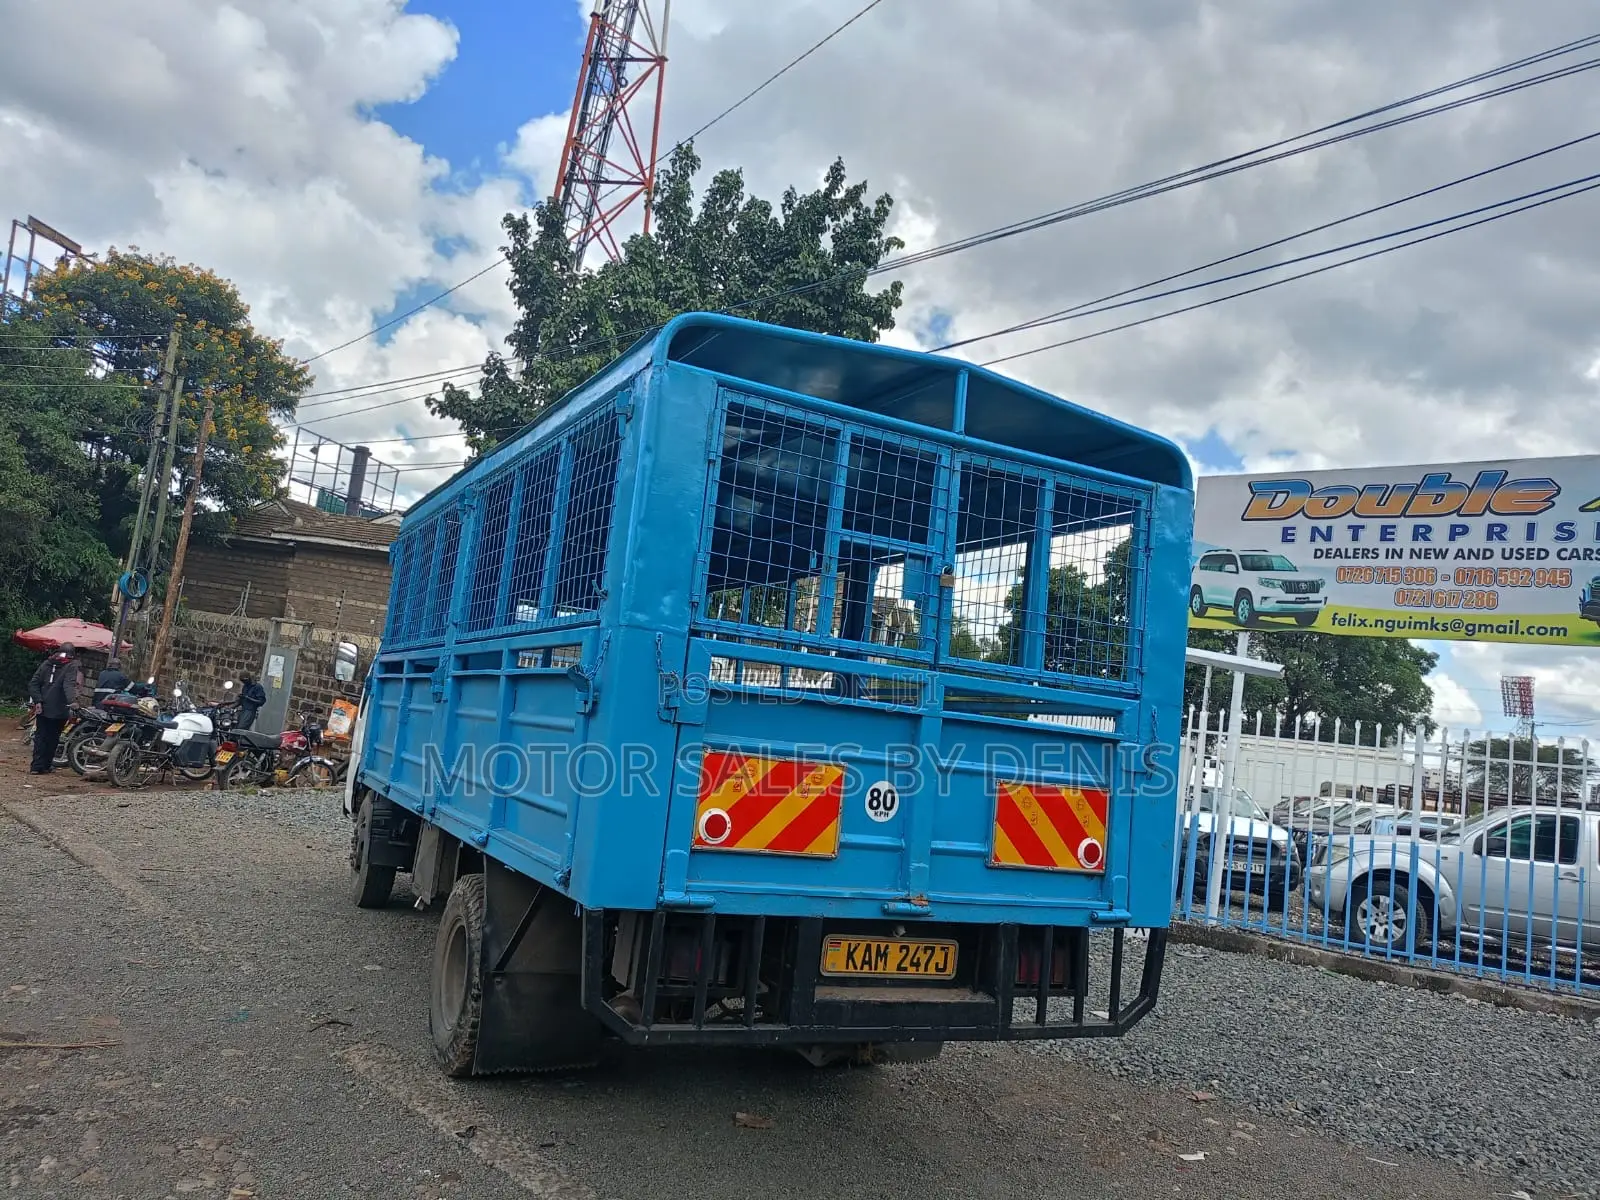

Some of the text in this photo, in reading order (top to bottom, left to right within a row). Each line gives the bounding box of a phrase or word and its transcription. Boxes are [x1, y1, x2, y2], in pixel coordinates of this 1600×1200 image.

[1241, 469, 1561, 521] Double
[1281, 521, 1600, 544] ENTERPRIS
[1313, 547, 1600, 561] DEALERS IN NEW AND USED CARS
[1336, 566, 1374, 584] 0726
[1375, 566, 1402, 584] 715
[1403, 566, 1437, 585] 306
[1454, 567, 1494, 586] 0716
[1496, 568, 1533, 587] 592
[1534, 568, 1572, 588] 945
[1394, 588, 1499, 610] 0721 617 286
[1331, 613, 1568, 637] felix.nguimks@gmail.com
[868, 787, 896, 812] 80
[873, 810, 890, 819] KPH
[845, 942, 949, 973] KAM 247J
